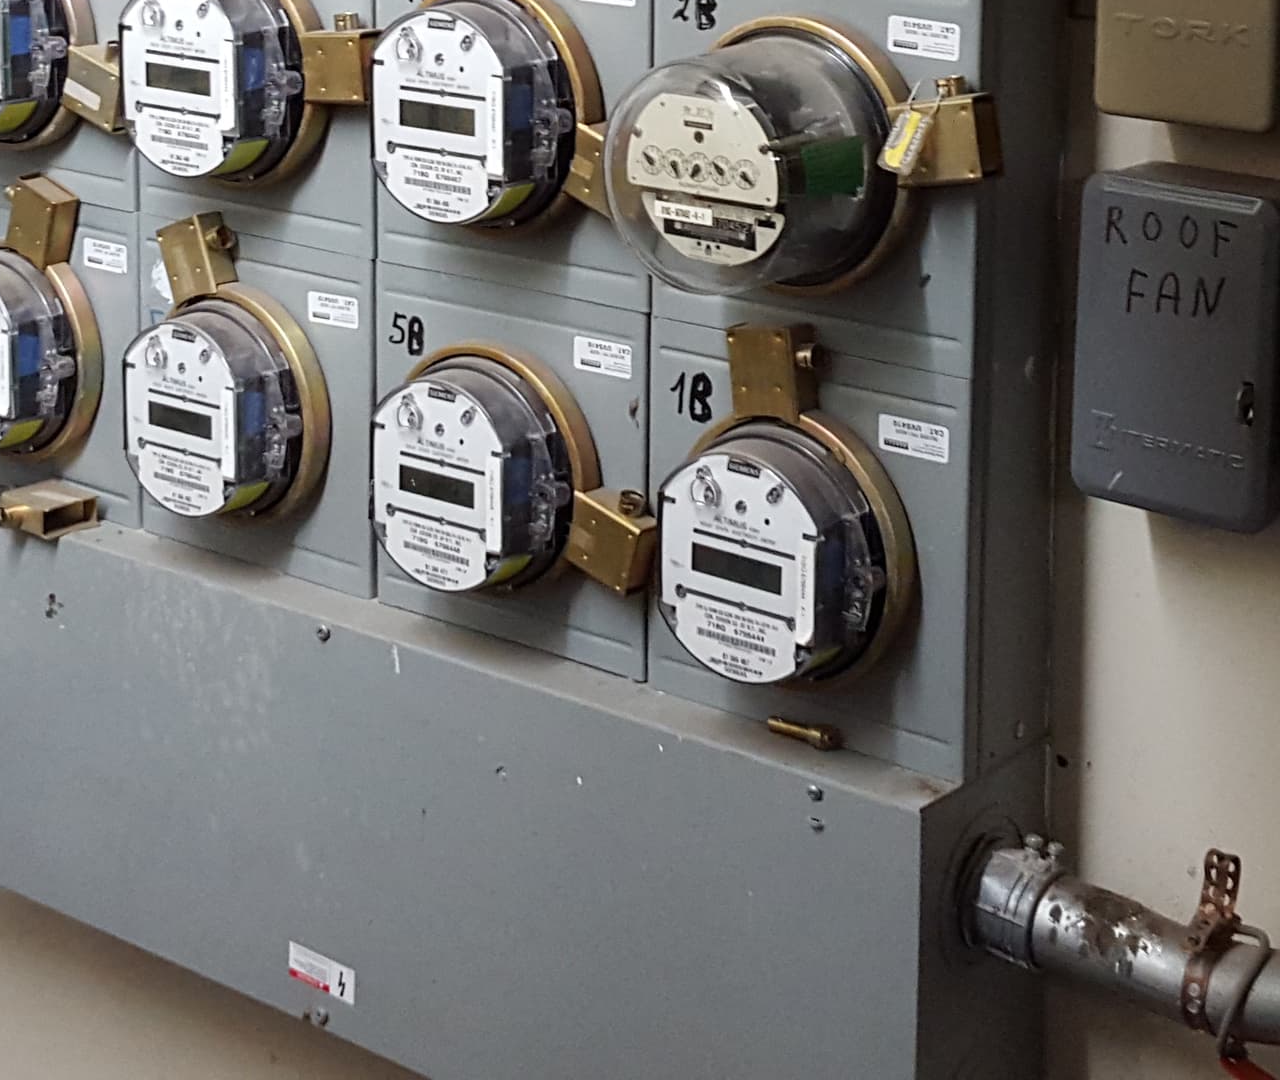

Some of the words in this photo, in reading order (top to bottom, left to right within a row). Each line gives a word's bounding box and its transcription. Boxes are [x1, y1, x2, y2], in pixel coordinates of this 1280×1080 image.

[1113, 11, 1250, 48] TORK
[1104, 205, 1240, 258] ROOF
[1124, 267, 1227, 318] FAN
[669, 370, 714, 424] 1B
